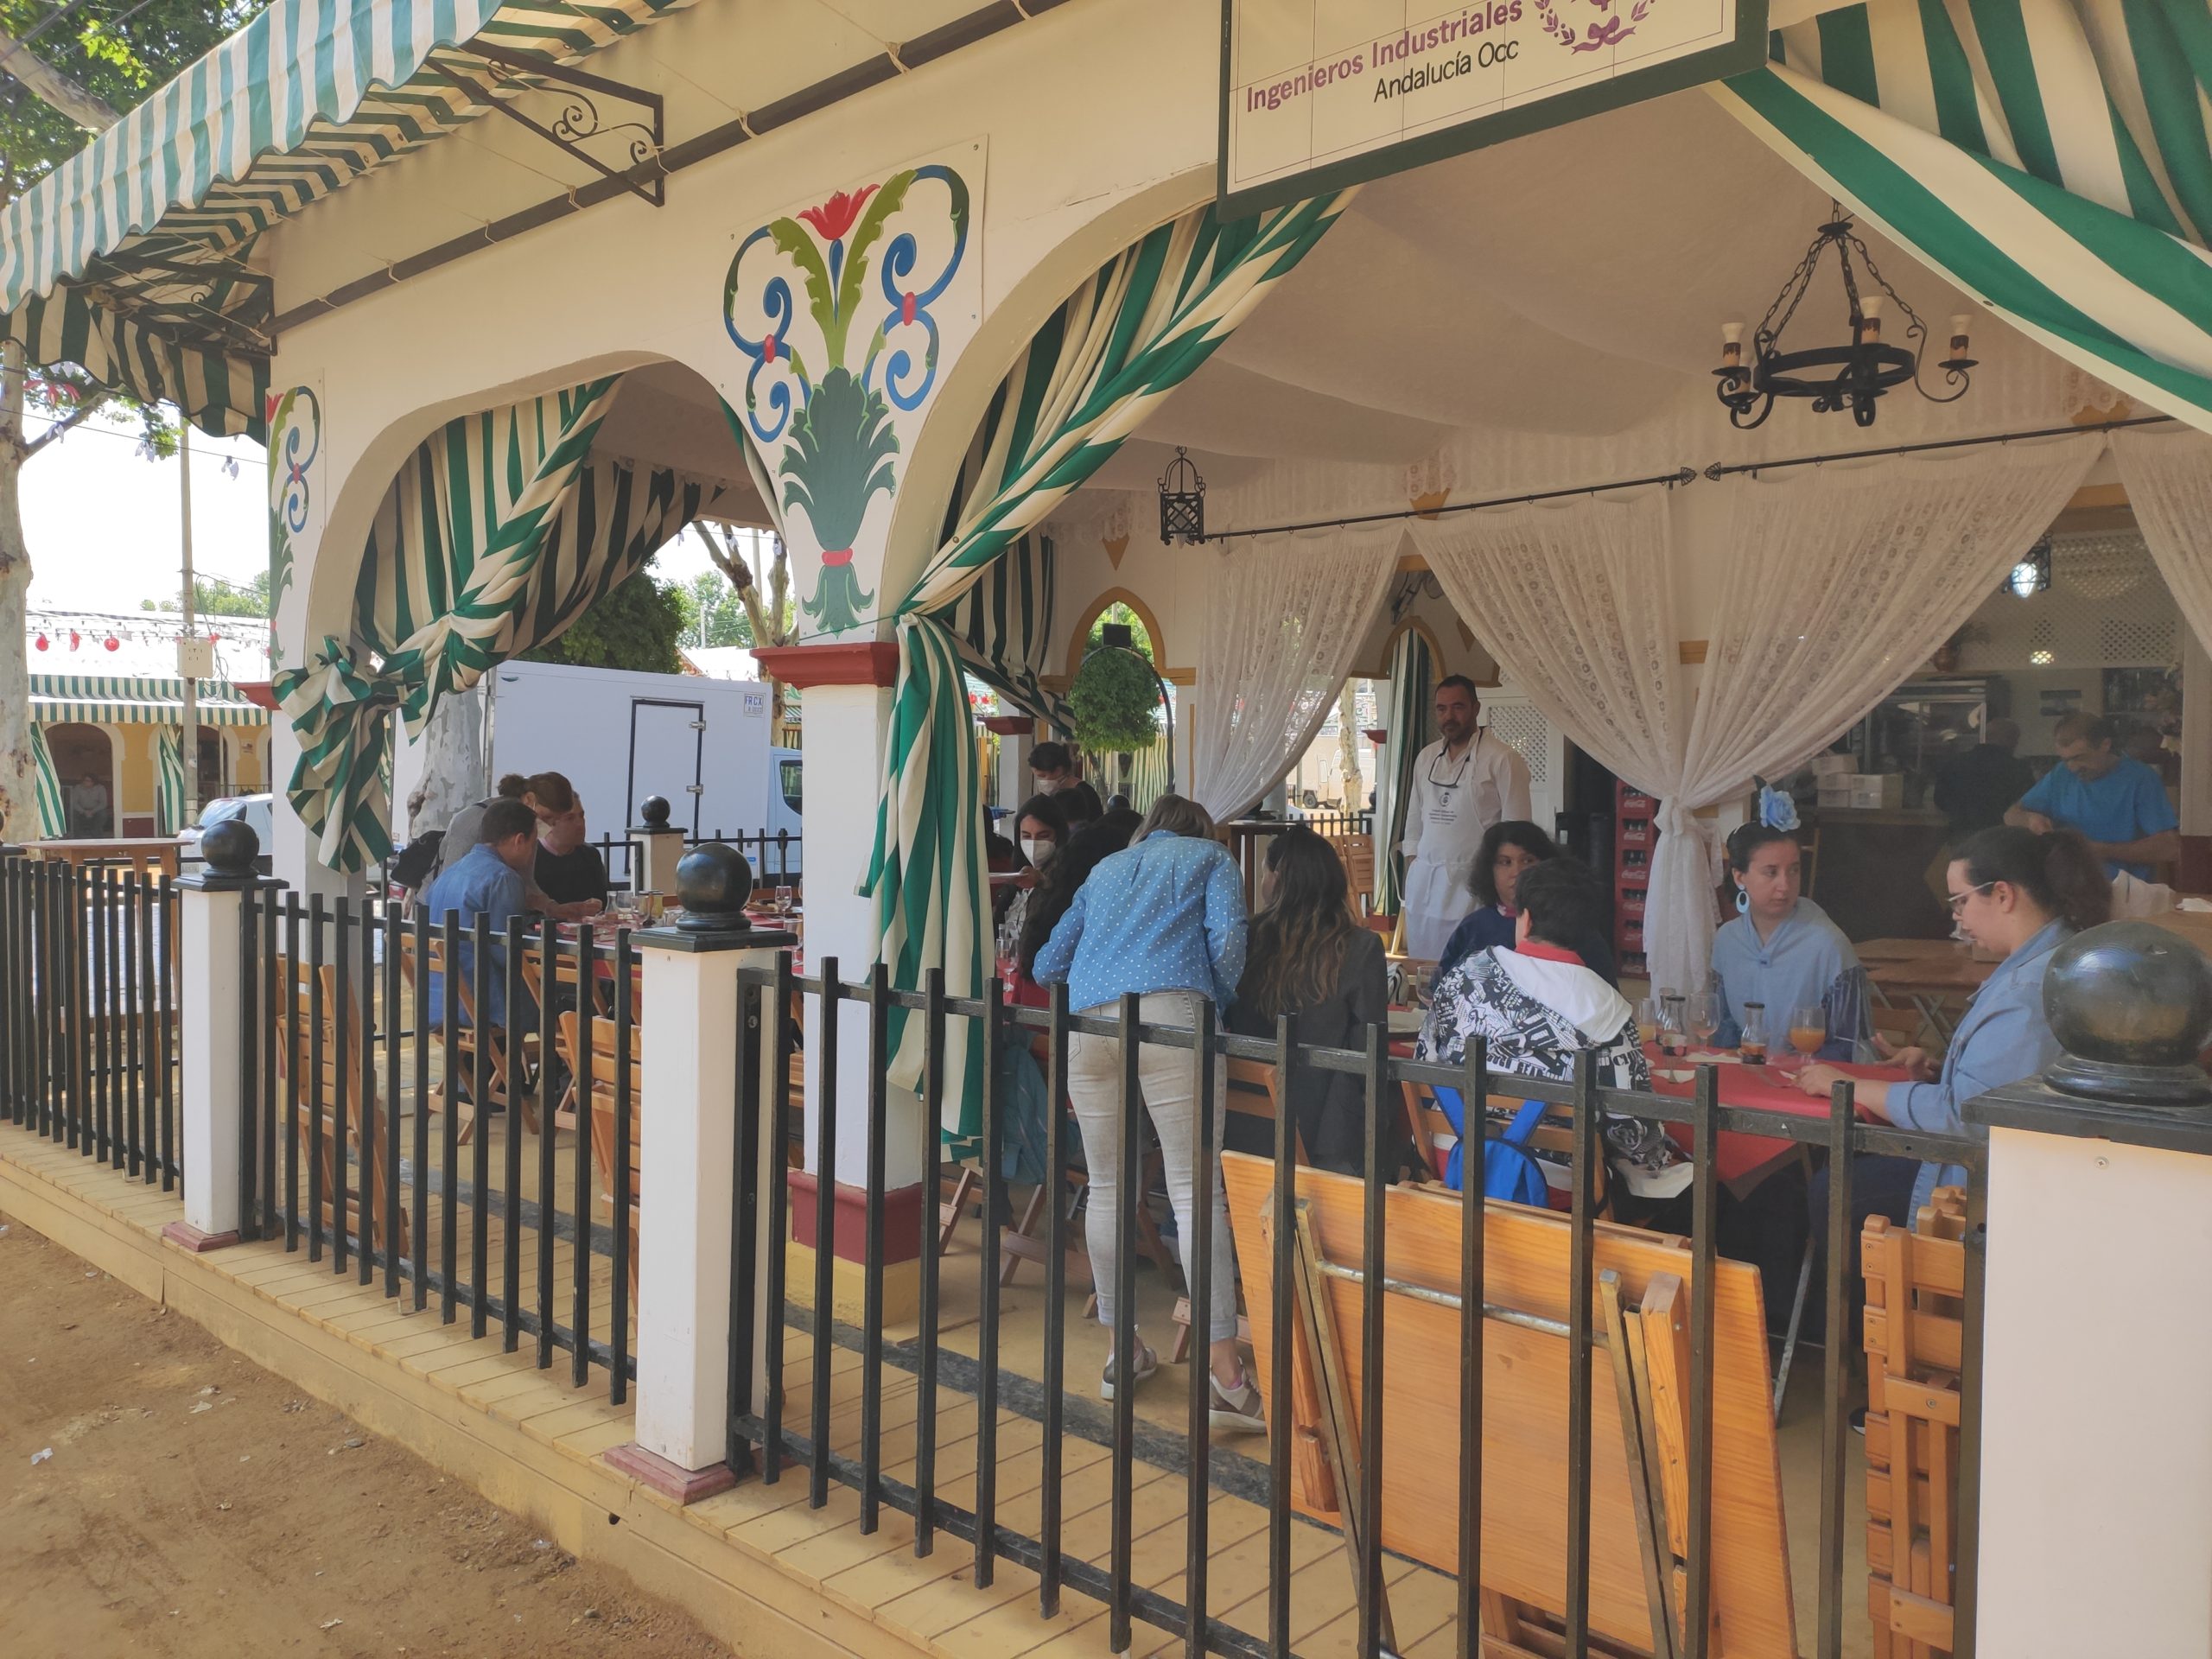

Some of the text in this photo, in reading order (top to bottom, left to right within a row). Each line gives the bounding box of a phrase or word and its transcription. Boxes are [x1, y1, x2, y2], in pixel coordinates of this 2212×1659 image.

[1247, 0, 1522, 112] Ingenieros Industriales
[1374, 40, 1519, 103] Andalucía Occ
